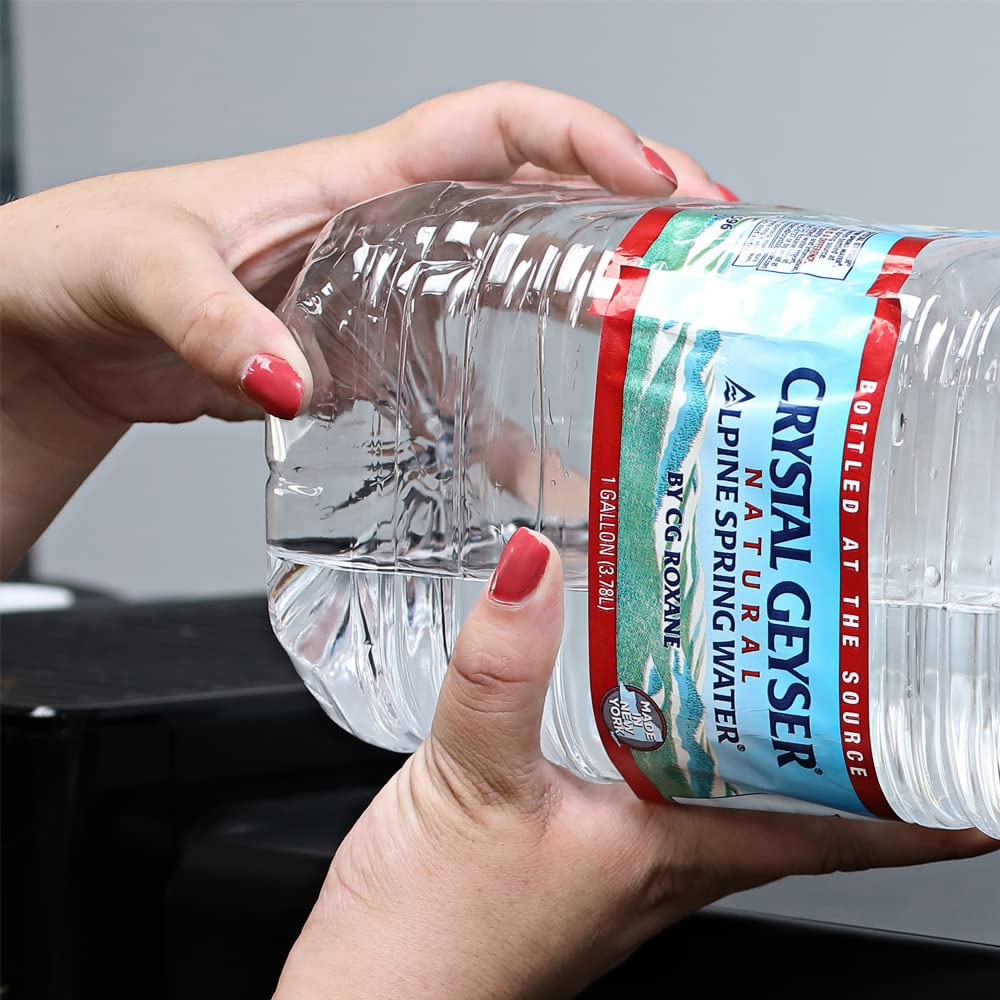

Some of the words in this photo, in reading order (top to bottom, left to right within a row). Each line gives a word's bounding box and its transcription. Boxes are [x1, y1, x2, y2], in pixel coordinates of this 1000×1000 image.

[769, 366, 827, 571] CRYSTAL
[842, 379, 879, 514] BOTTLED
[666, 471, 684, 503] BY
[599, 490, 617, 556] GALLON
[664, 508, 683, 542] CG
[712, 509, 738, 632] SPRING
[741, 467, 763, 683] NATURAL
[842, 536, 859, 573] AT
[597, 561, 615, 611] (3.78L)
[663, 550, 681, 648] ROXANE
[842, 595, 860, 648] THE
[609, 698, 625, 736] YORK
[620, 701, 635, 736] NEW
[632, 713, 643, 727] IN
[640, 700, 656, 742] MADE
[842, 670, 868, 777] SOURCE
